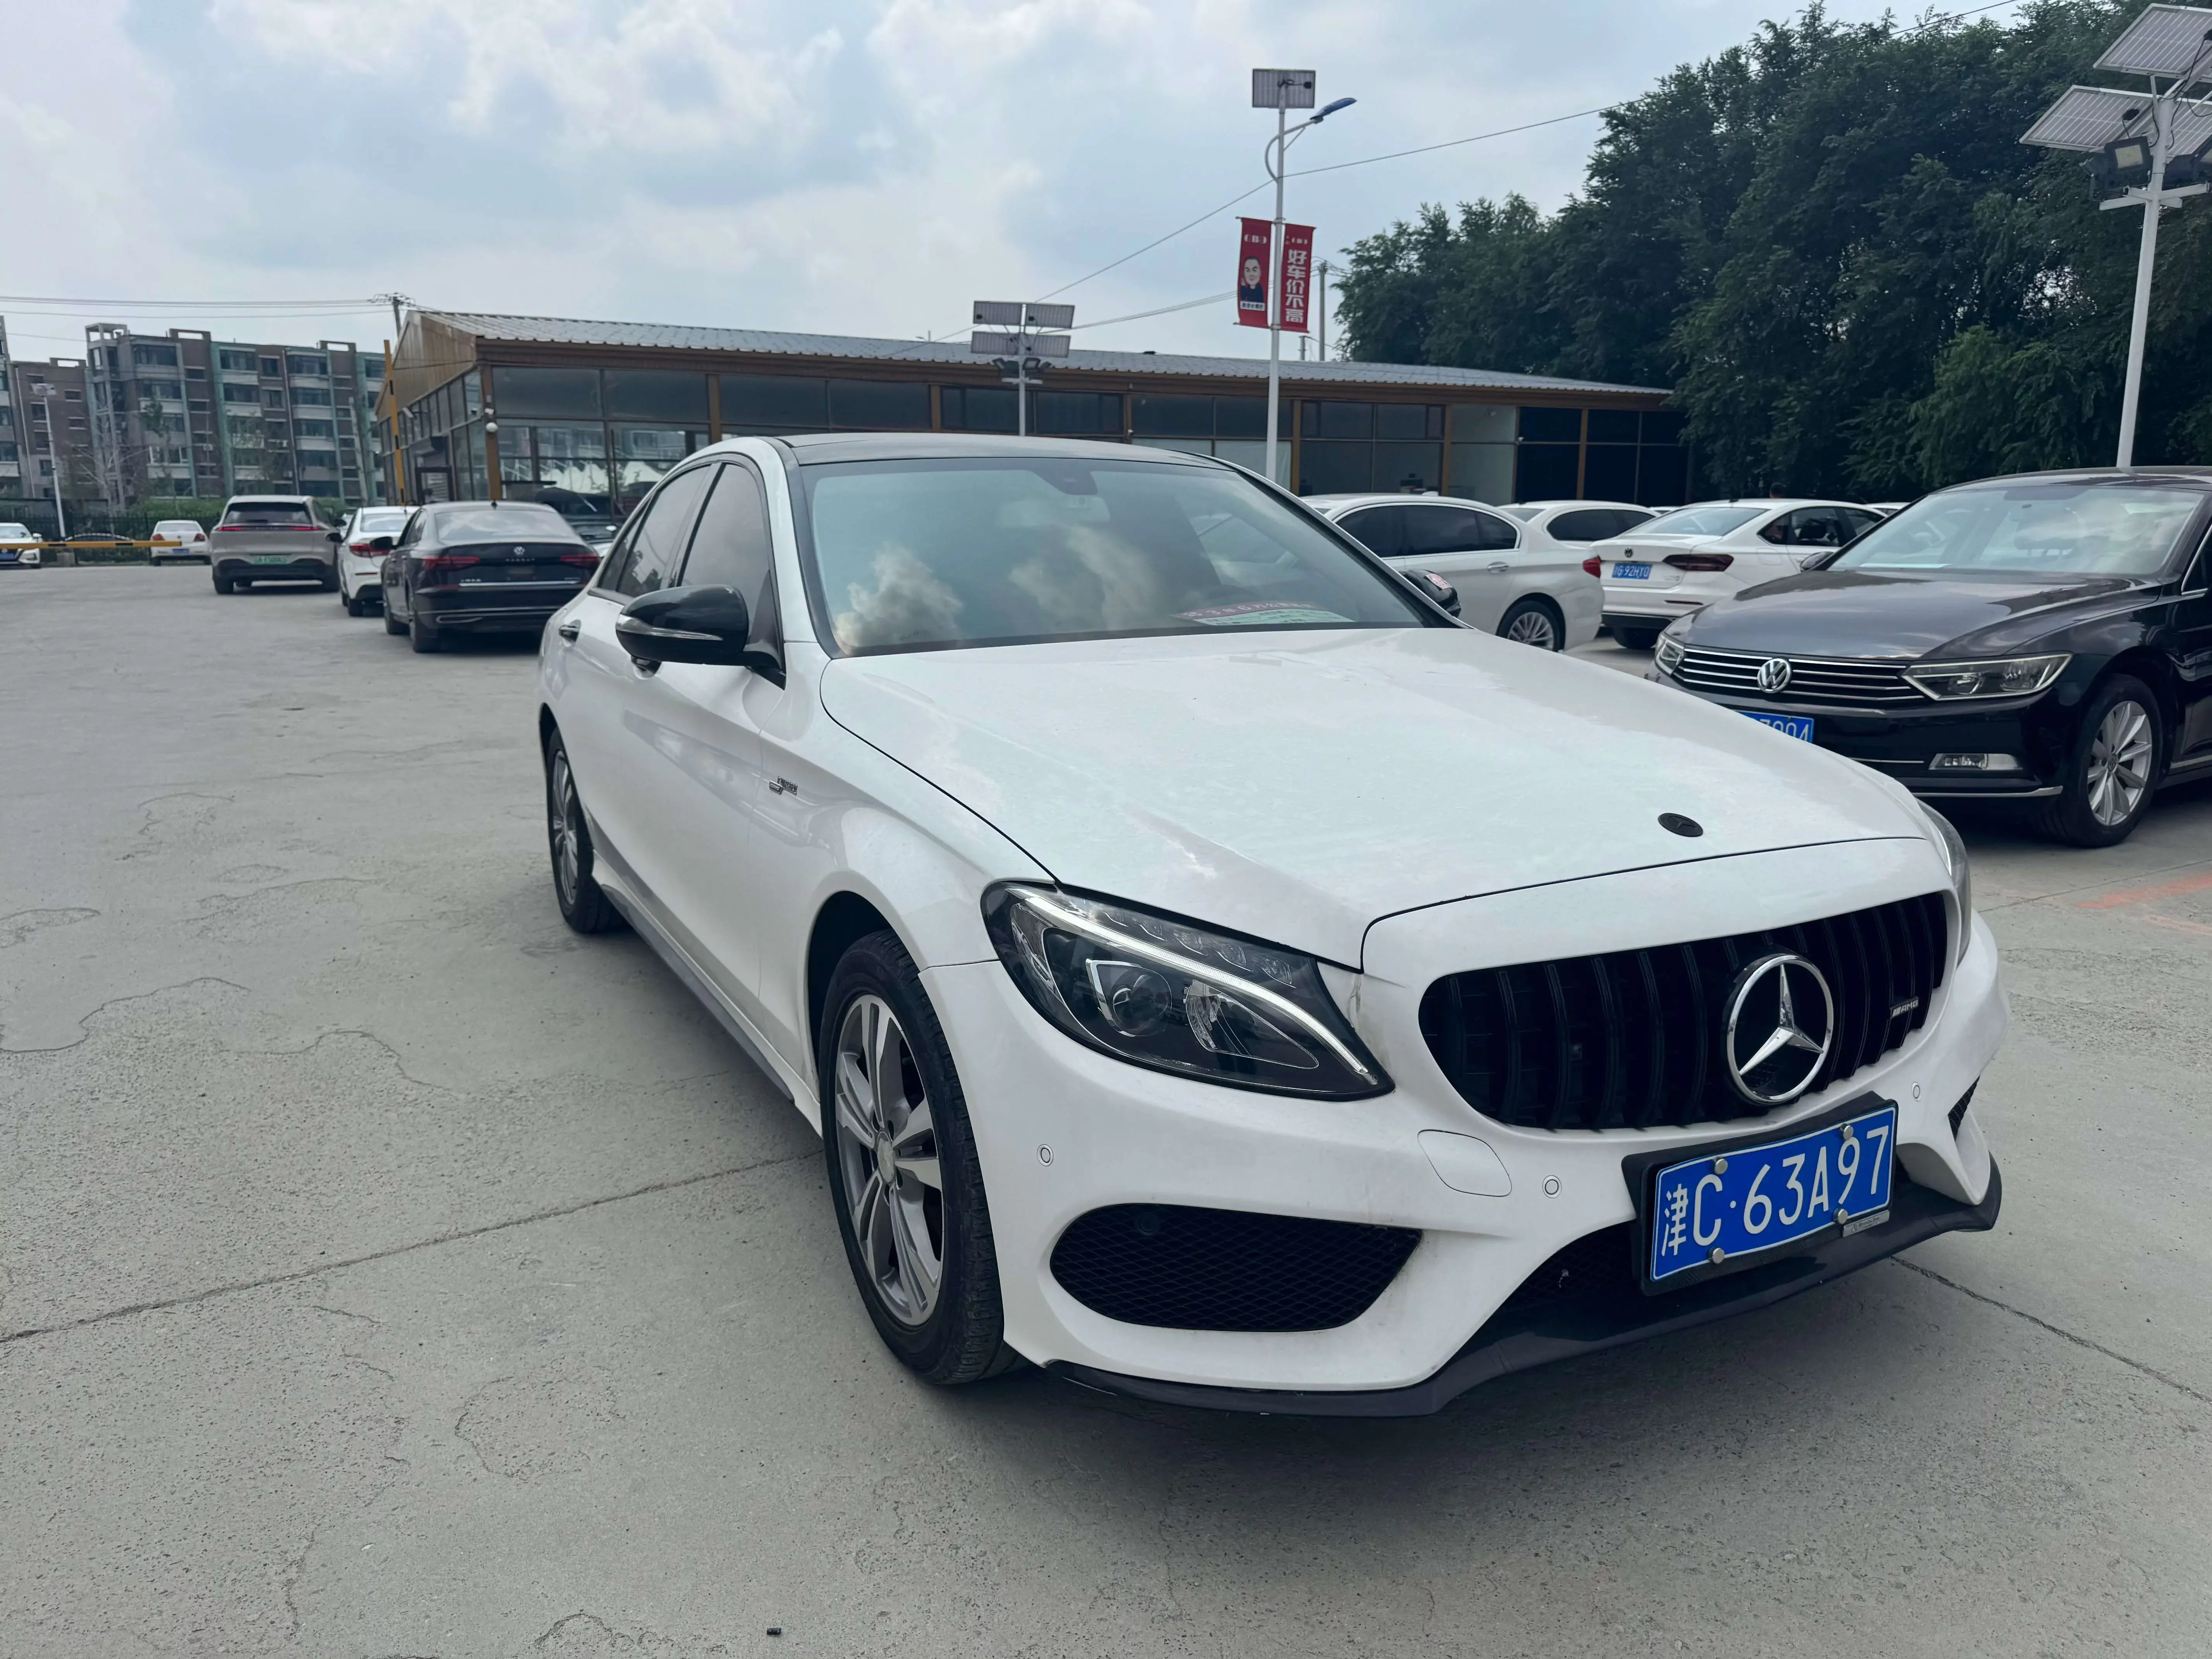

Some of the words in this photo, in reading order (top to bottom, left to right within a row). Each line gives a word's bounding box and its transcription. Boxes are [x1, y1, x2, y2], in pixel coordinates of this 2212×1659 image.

[1285, 249, 1307, 323] 好车价不高
[1661, 1125, 1890, 1257] 津C·63A97
